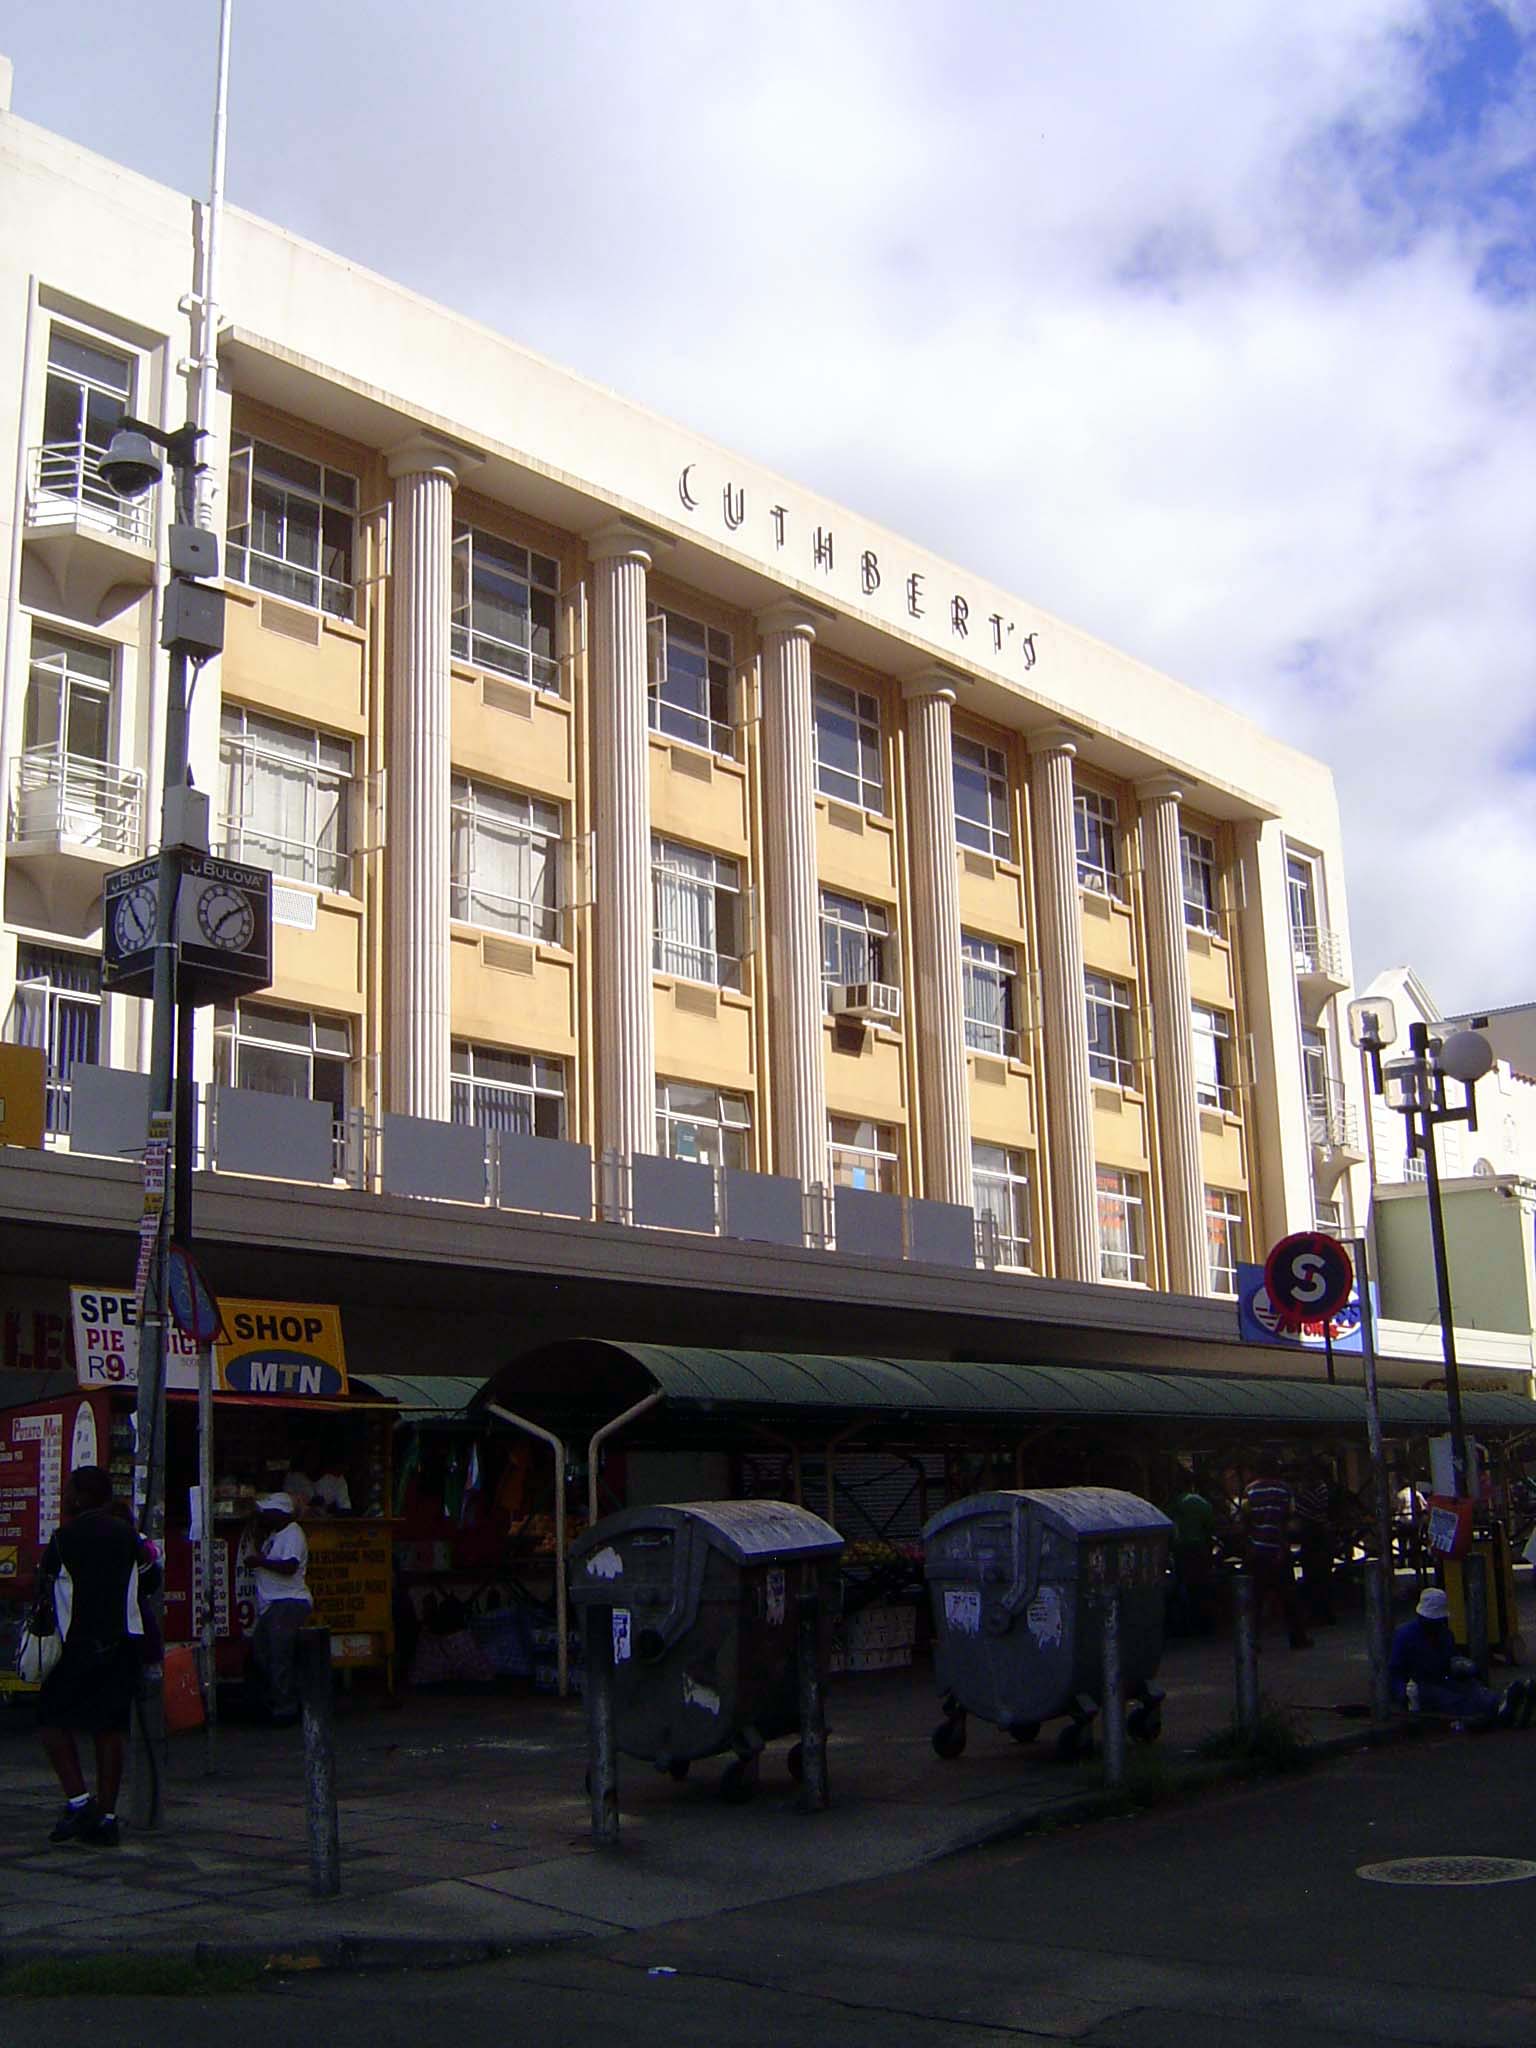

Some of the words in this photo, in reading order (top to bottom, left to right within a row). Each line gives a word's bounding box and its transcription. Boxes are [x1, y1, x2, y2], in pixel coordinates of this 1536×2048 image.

[678, 463, 1039, 671] CUTHBERT'S
[120, 862, 160, 888] BULOV
[203, 862, 262, 888] BULOVA
[87, 1328, 125, 1353] PIE
[234, 1313, 322, 1343] SHOP
[250, 1360, 322, 1396] MTN
